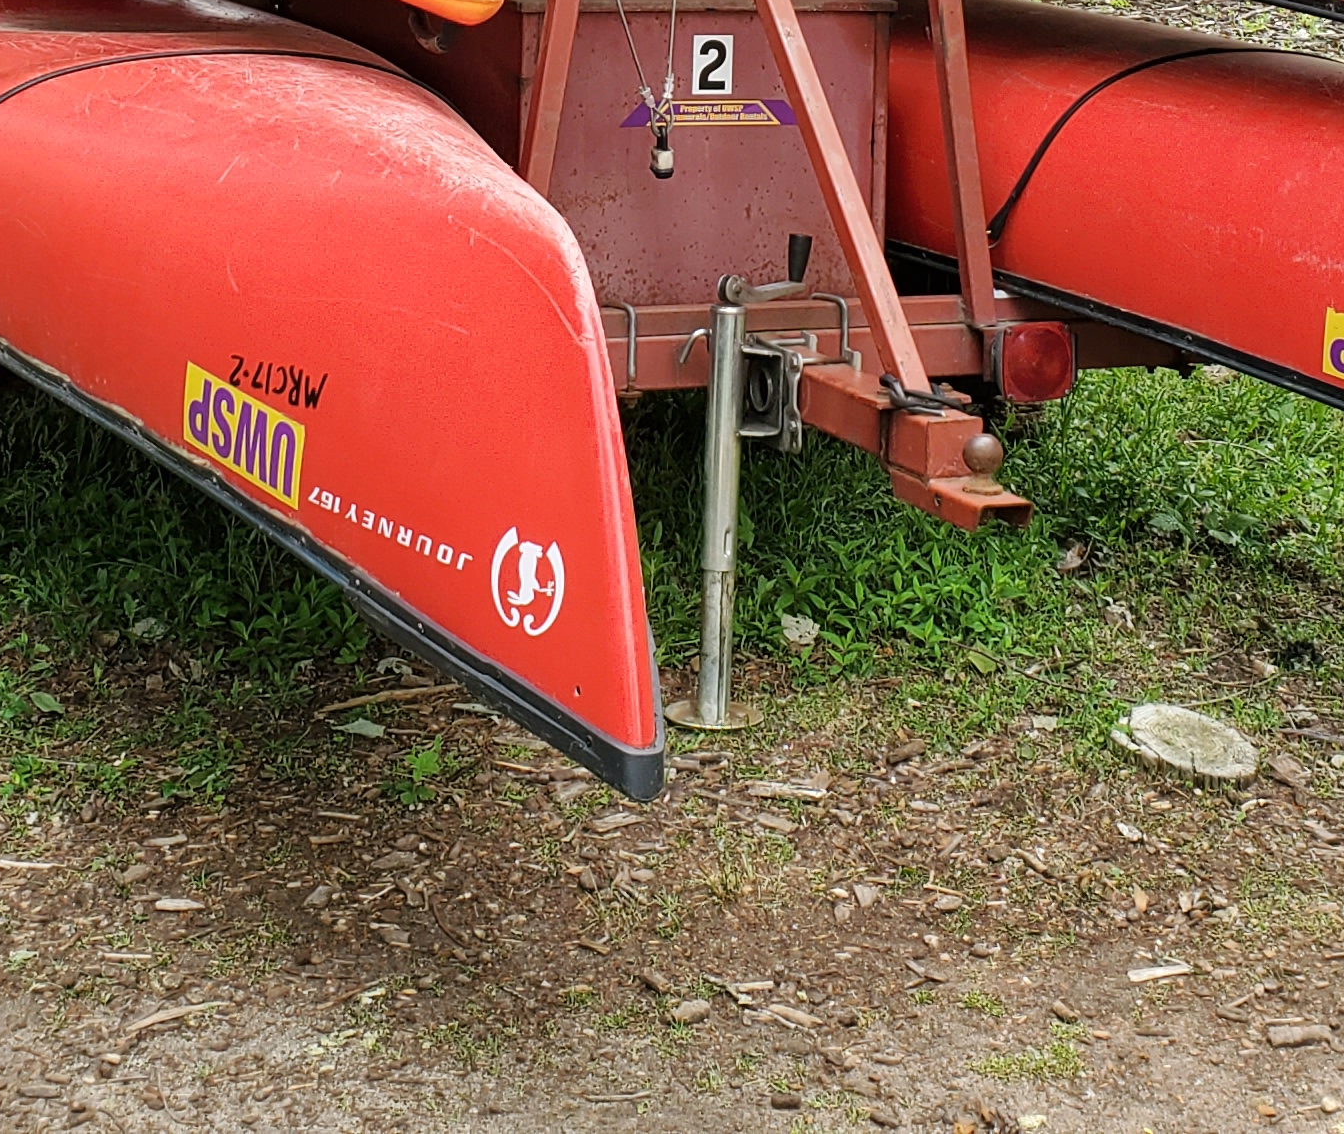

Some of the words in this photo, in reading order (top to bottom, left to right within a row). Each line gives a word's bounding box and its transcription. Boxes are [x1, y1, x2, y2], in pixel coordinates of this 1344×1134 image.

[698, 38, 728, 91] 2
[679, 104, 713, 114] Property
[713, 104, 722, 113] of
[187, 377, 297, 499] UWSP
[343, 503, 474, 571] JOURNEY
